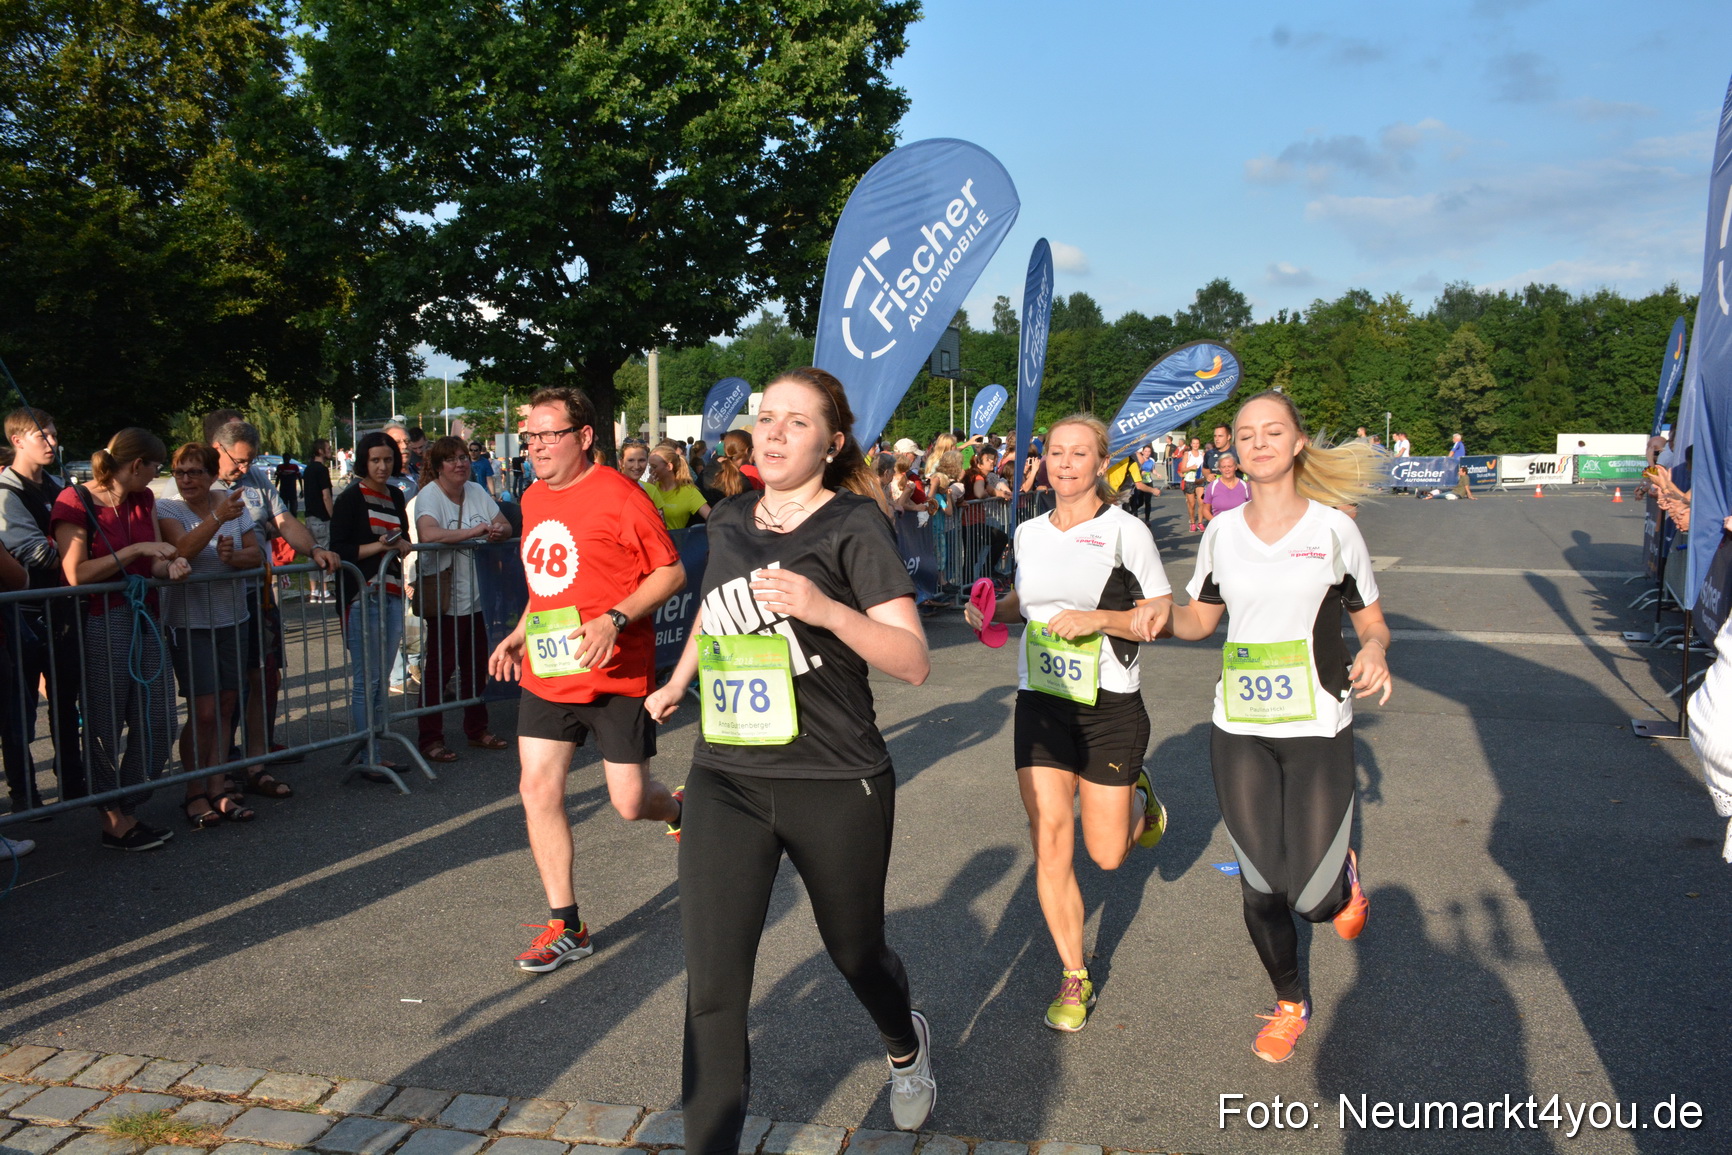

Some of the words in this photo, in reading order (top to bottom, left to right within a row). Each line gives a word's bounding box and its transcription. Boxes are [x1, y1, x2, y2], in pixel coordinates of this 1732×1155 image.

[869, 178, 978, 333] Fischer
[908, 209, 989, 333] AUTOMOBILE
[713, 385, 742, 423] Fischer
[979, 391, 1001, 423] Fischer
[1117, 380, 1205, 434] Frischmann
[1174, 396, 1195, 411] Druck
[1209, 375, 1235, 393] Medien
[1400, 468, 1445, 478] Fischer
[1528, 462, 1556, 475] swn
[526, 537, 568, 578] 48
[536, 635, 569, 660] 501
[1040, 652, 1082, 681] 395
[713, 678, 771, 714] 978
[1238, 674, 1294, 702] 393
